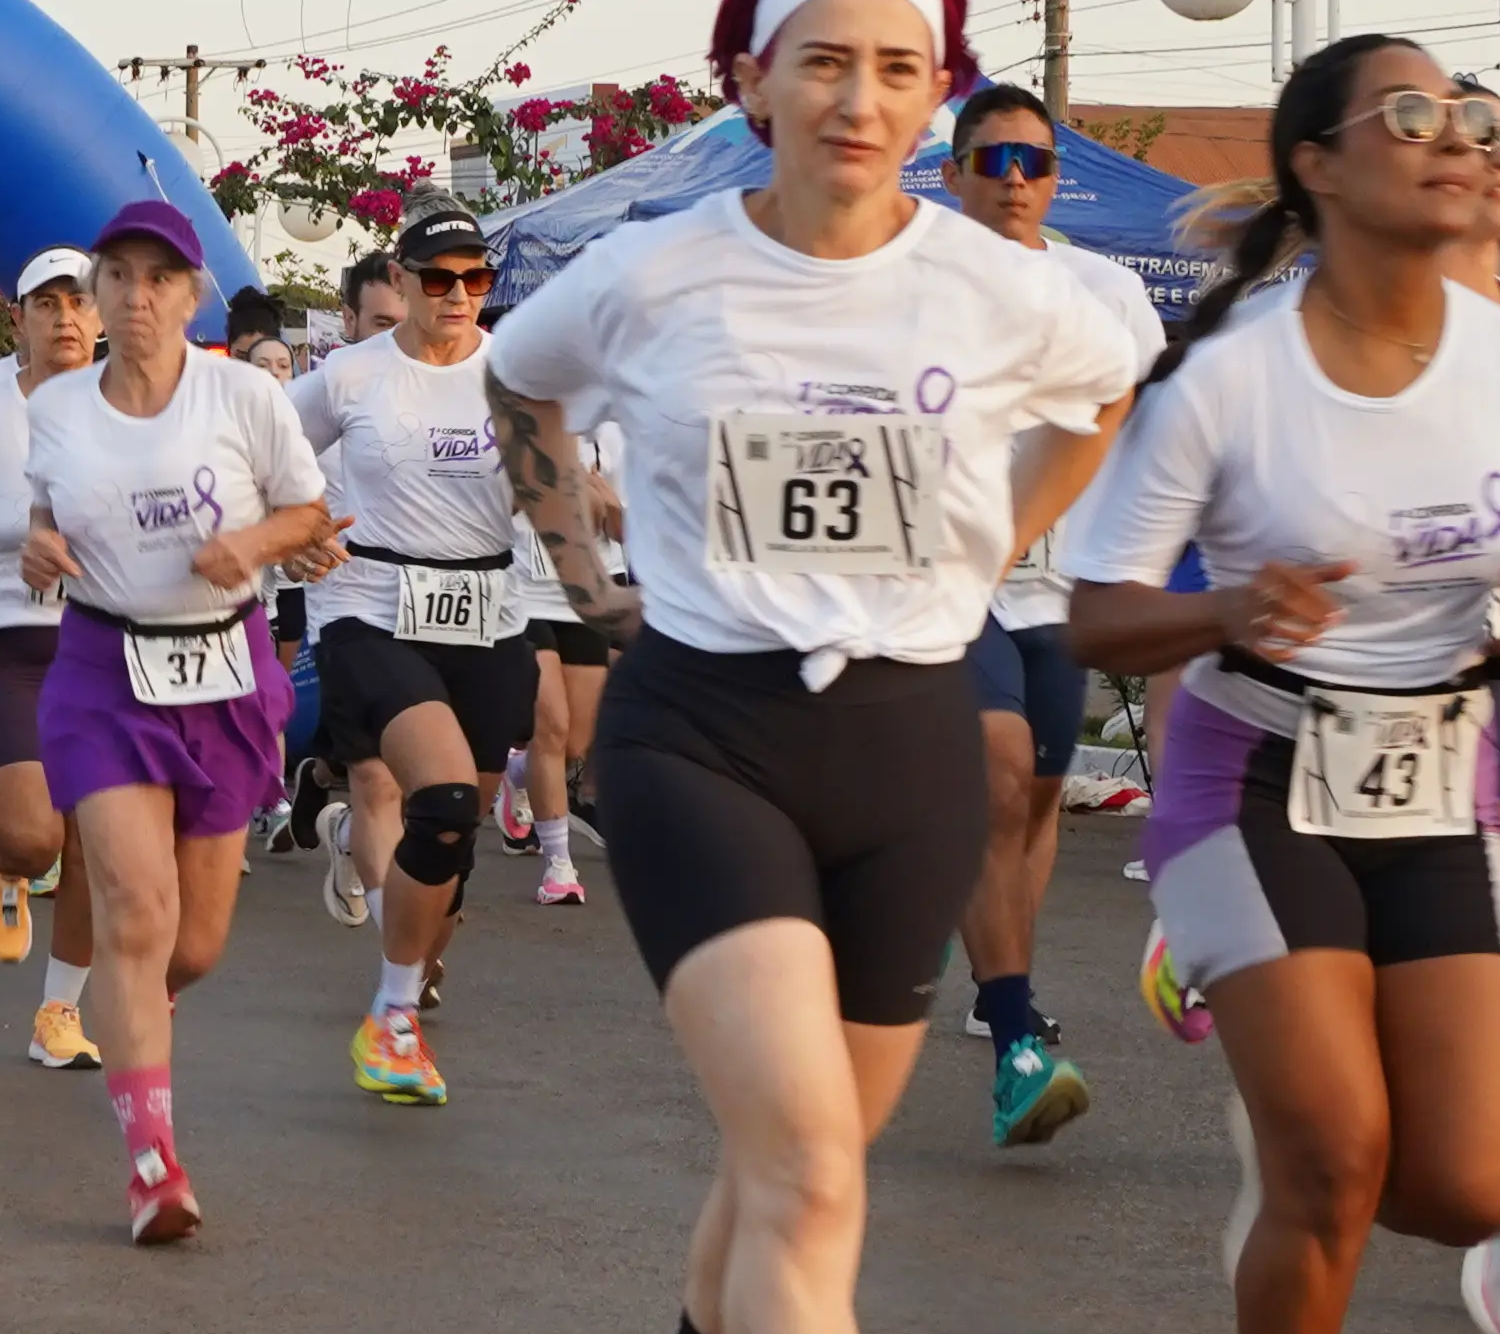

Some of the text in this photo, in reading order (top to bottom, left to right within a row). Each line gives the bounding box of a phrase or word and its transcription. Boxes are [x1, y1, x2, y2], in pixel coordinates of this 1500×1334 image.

[1106, 255, 1216, 277] METRAGEM
[432, 437, 479, 458] VIDA
[136, 496, 189, 530] VIDA
[782, 478, 860, 541] 63
[425, 592, 472, 626] 106
[167, 651, 206, 685] 37
[1355, 752, 1420, 809] 43
